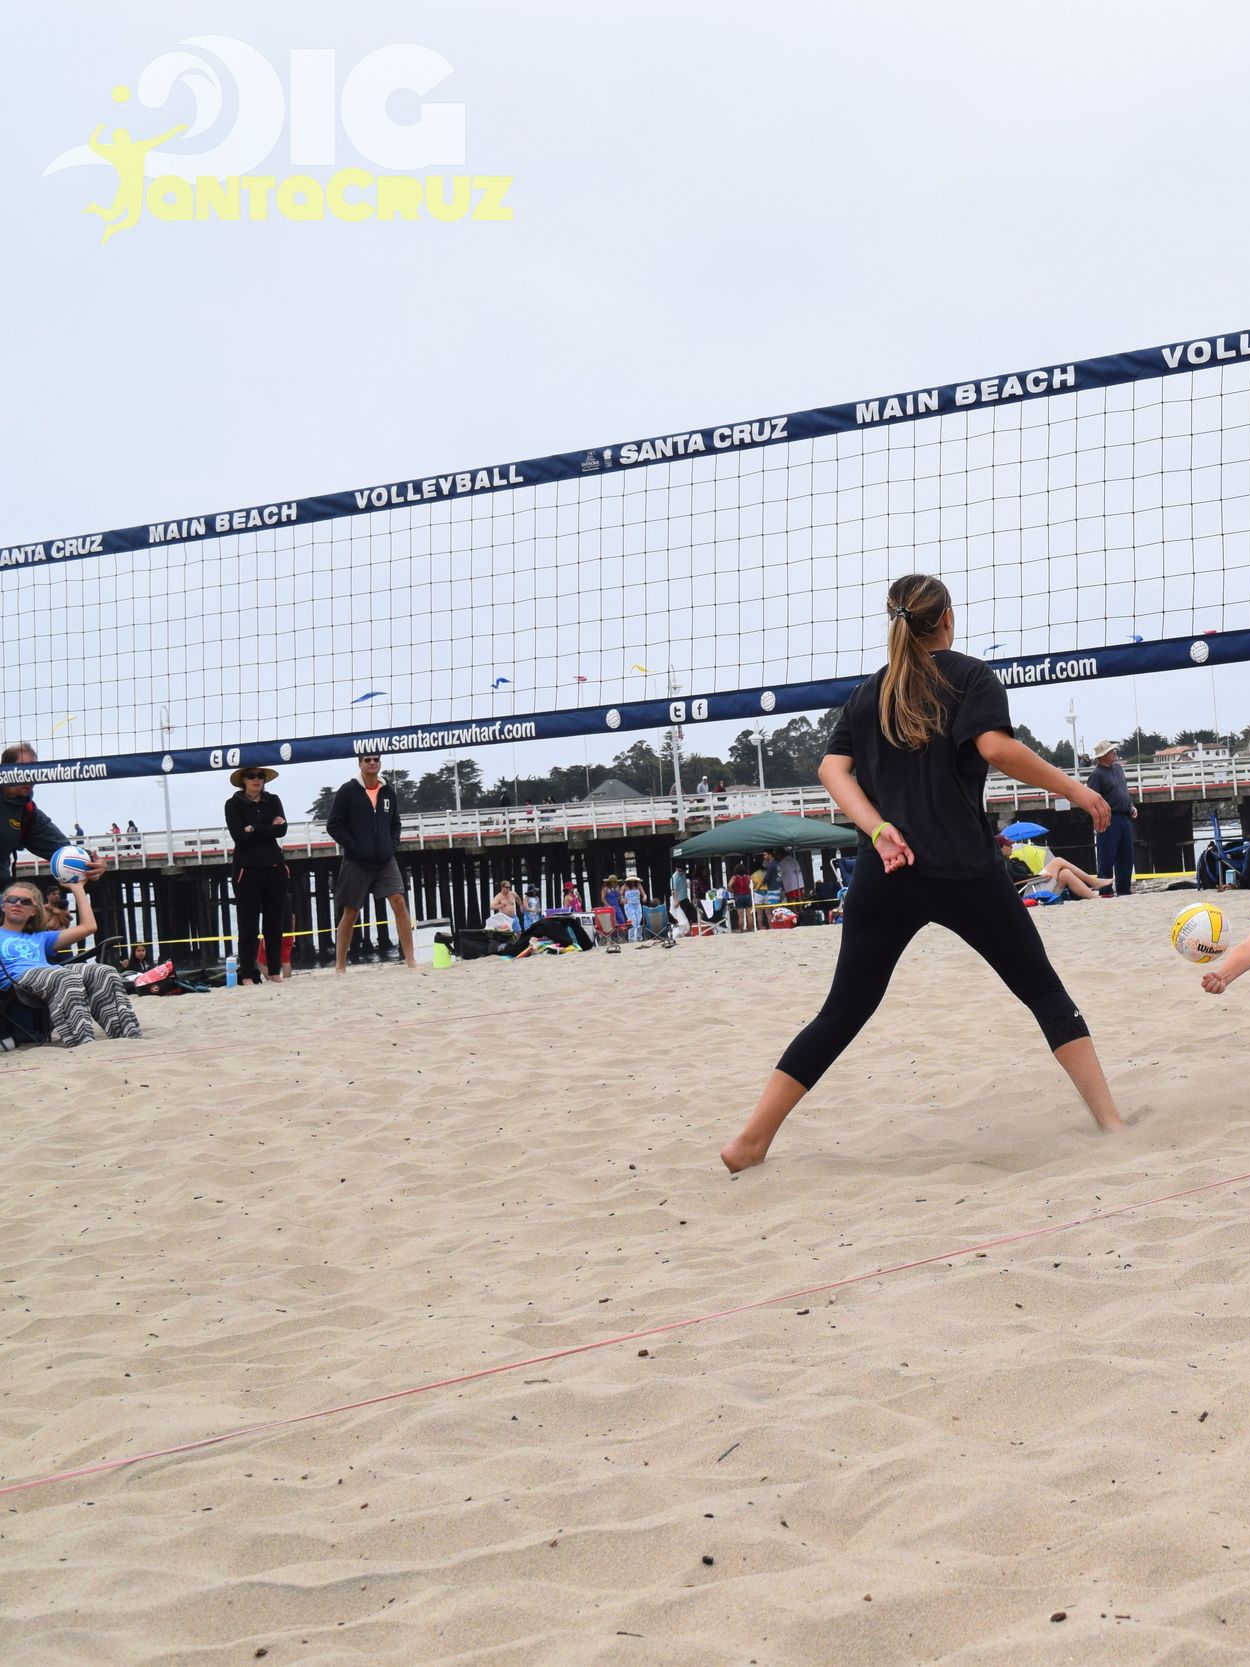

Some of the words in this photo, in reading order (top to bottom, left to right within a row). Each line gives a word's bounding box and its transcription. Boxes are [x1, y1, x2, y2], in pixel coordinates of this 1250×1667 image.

[856, 390, 939, 424] MAIN
[955, 365, 1075, 406] BEACH
[620, 433, 705, 465] SANTA
[713, 417, 788, 449] CRUZ
[355, 465, 524, 509] VOLLEYBALL
[148, 518, 206, 543] MAIN
[215, 503, 297, 533] BEACH
[51, 535, 103, 558] CRUZ
[993, 658, 1098, 685] wharf.com
[353, 721, 536, 754] www.santacruzwharf.com
